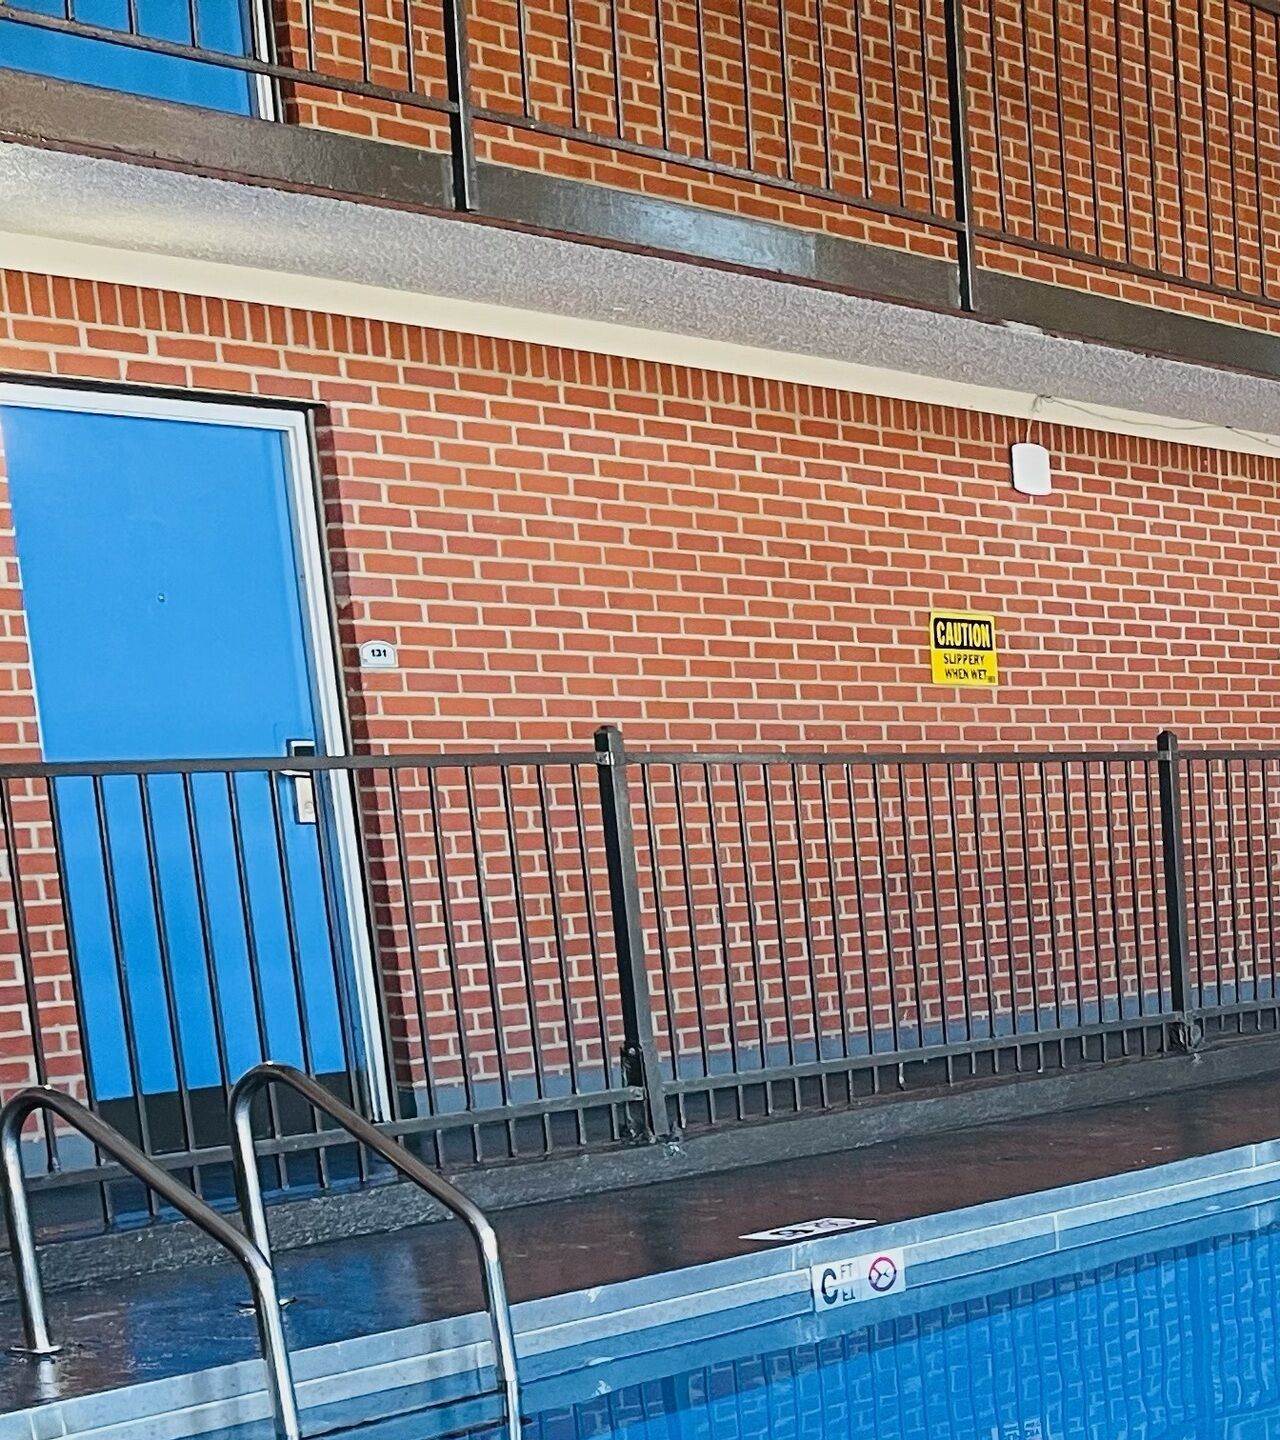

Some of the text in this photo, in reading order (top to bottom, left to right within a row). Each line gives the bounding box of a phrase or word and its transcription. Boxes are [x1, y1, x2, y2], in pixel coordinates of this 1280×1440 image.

[936, 621, 991, 648] CAUTION
[944, 653, 985, 664] SLIPPERY
[945, 669, 968, 679] WHEN
[971, 669, 987, 679] WET
